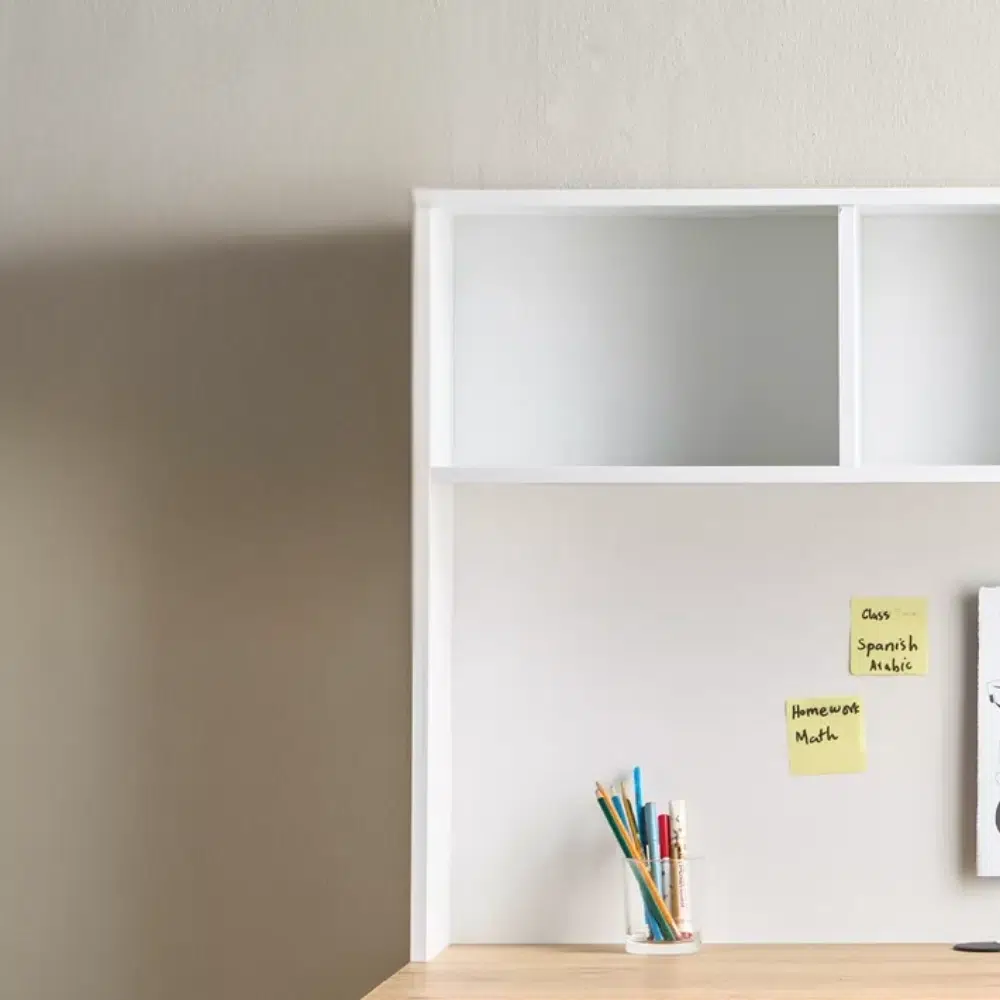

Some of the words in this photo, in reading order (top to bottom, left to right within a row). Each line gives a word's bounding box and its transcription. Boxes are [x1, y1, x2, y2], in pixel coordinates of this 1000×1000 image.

[861, 608, 891, 621] Class
[857, 635, 918, 657] Spanish
[869, 657, 913, 673] Arabic
[795, 726, 839, 745] Math
